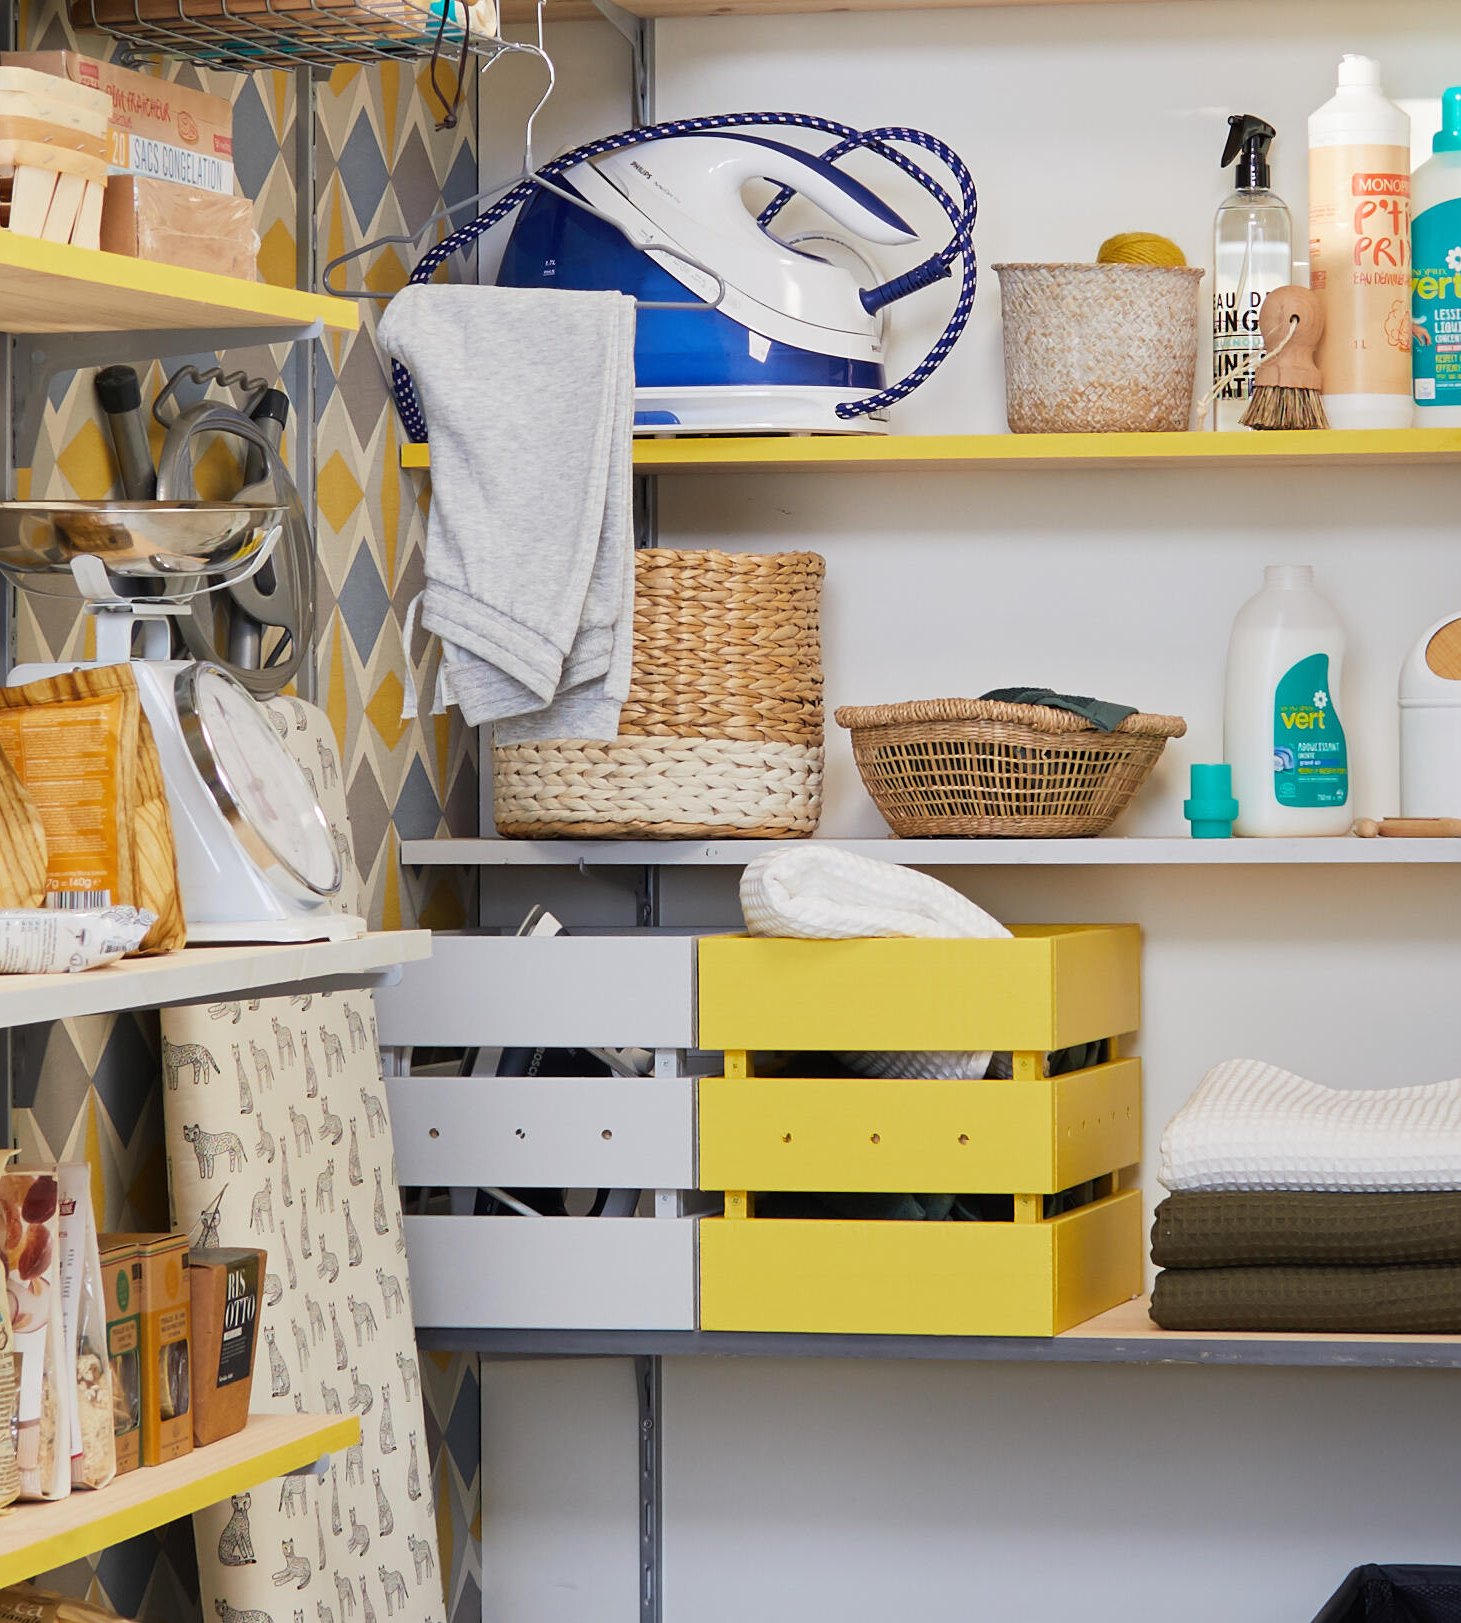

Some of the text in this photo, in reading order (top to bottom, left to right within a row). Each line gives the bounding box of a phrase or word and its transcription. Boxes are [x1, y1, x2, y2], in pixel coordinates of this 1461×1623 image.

[111, 129, 127, 164] 20
[134, 138, 223, 192] SACS CONGELATION
[1281, 709, 1326, 730] vert
[227, 1270, 246, 1301] RIS
[224, 1294, 256, 1329] OTTO
